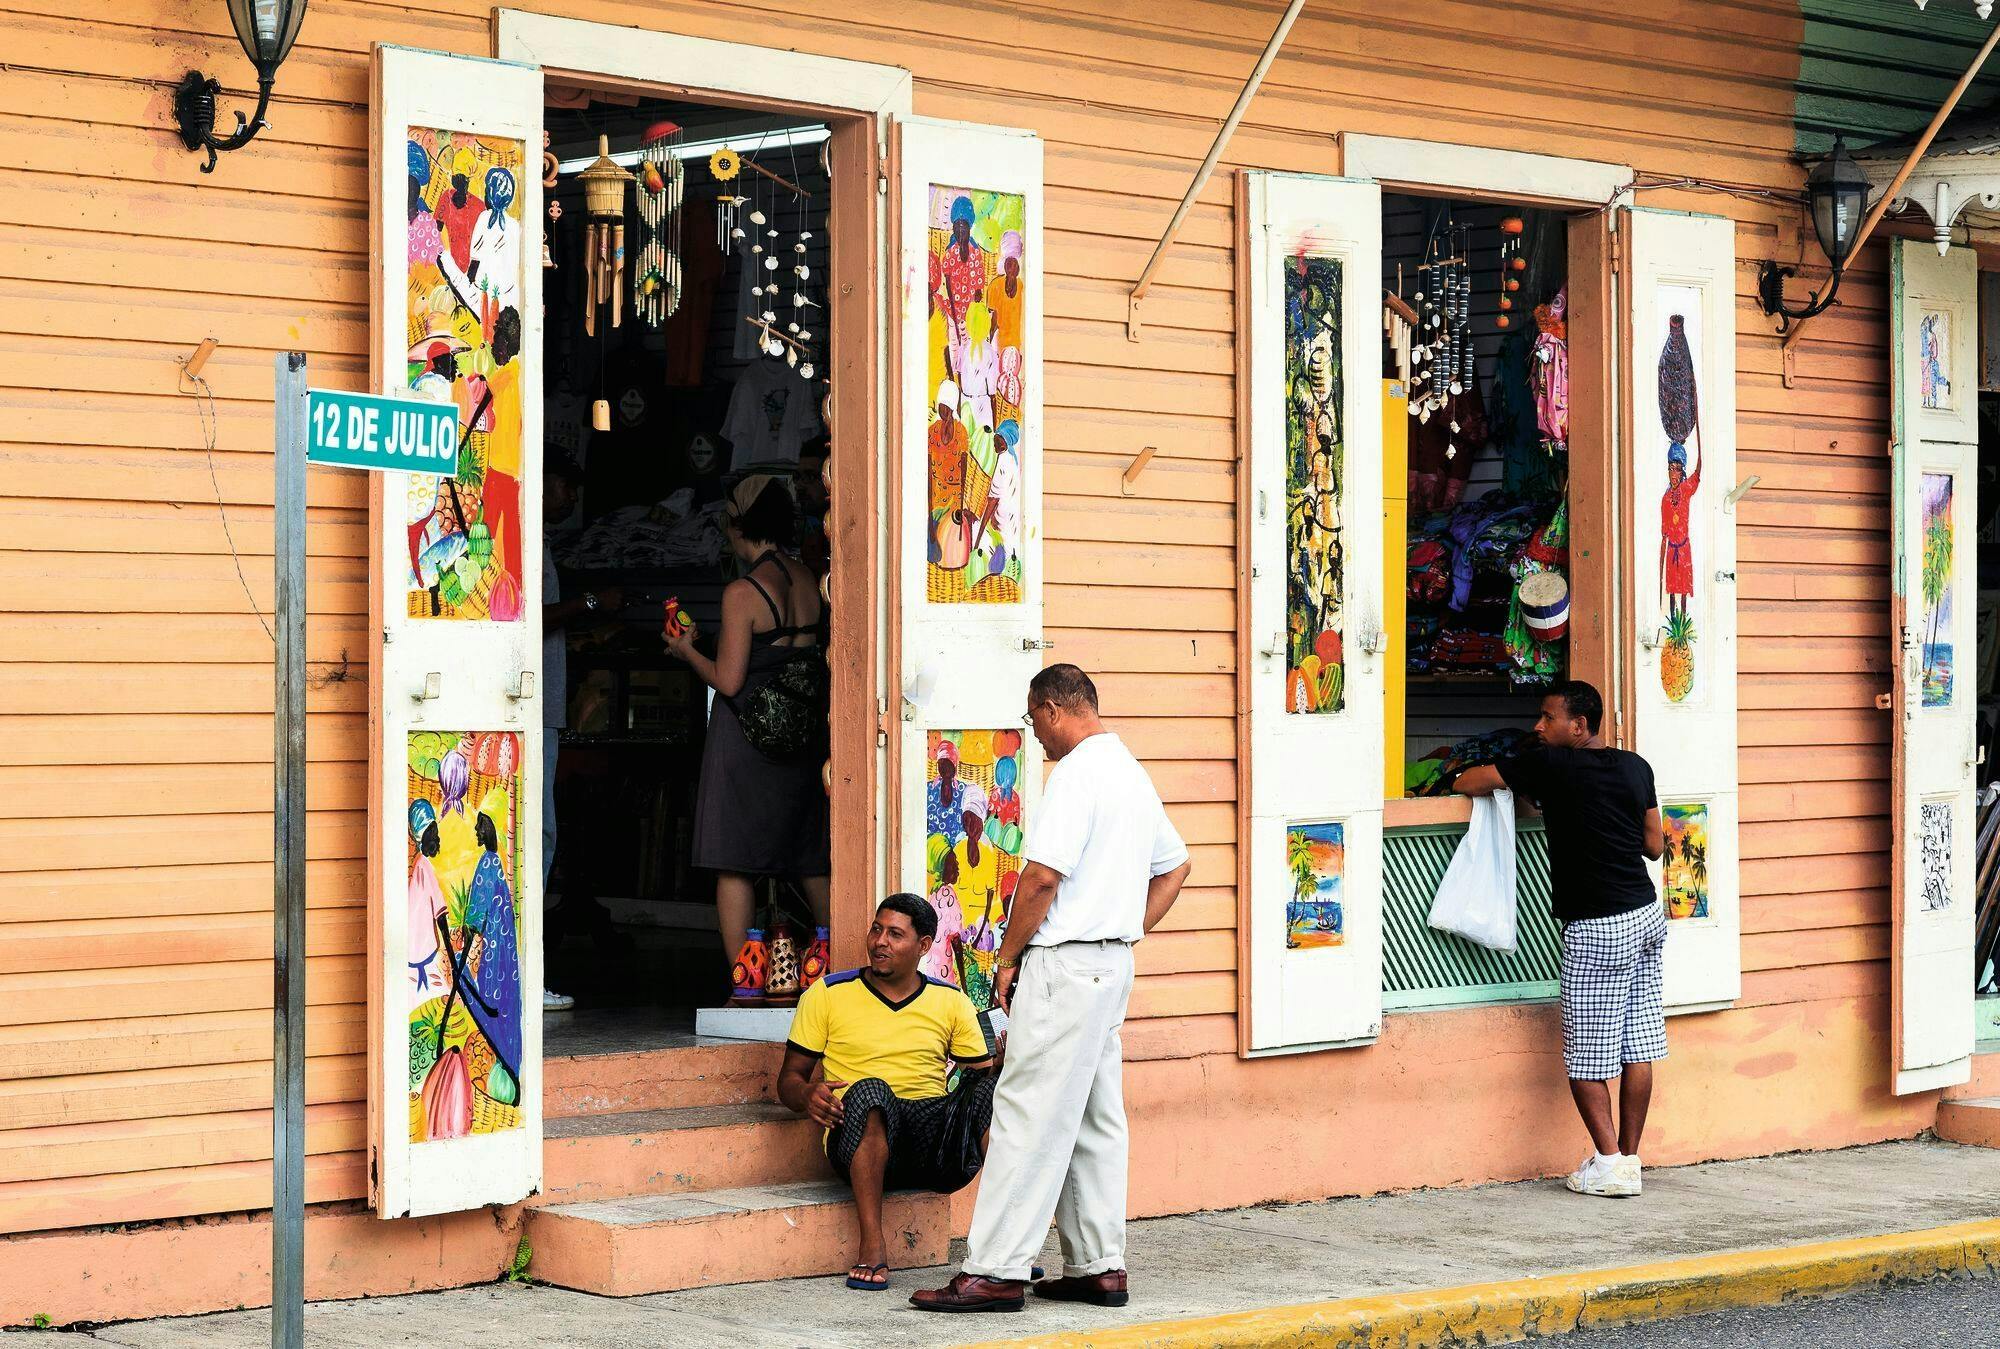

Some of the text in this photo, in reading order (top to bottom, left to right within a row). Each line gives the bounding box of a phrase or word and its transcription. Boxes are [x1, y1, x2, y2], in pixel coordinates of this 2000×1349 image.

[313, 401, 455, 460] 12 DE JULIO
